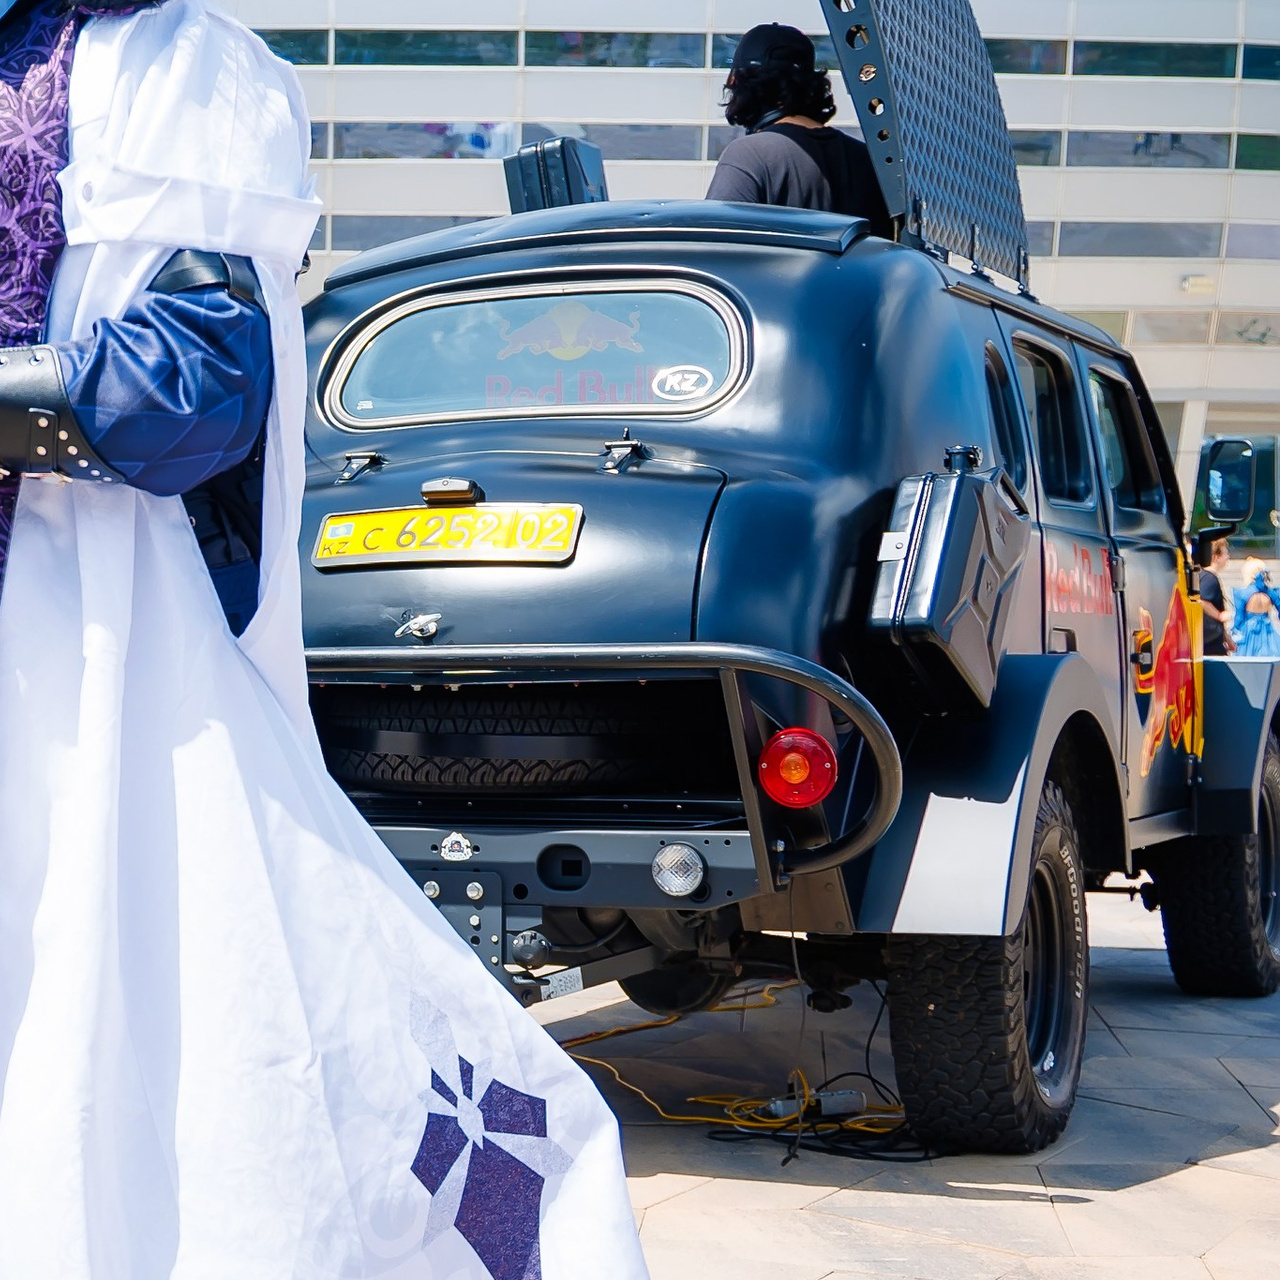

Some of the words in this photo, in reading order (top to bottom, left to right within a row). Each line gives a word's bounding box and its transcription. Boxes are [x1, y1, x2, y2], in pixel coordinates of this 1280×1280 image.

[485, 370, 563, 407] Red
[578, 365, 656, 404] Bull
[665, 371, 702, 392] KZ
[396, 514, 500, 548] 6252
[516, 514, 569, 548] 02
[322, 542, 349, 556] KZ
[1045, 542, 1080, 613] Red
